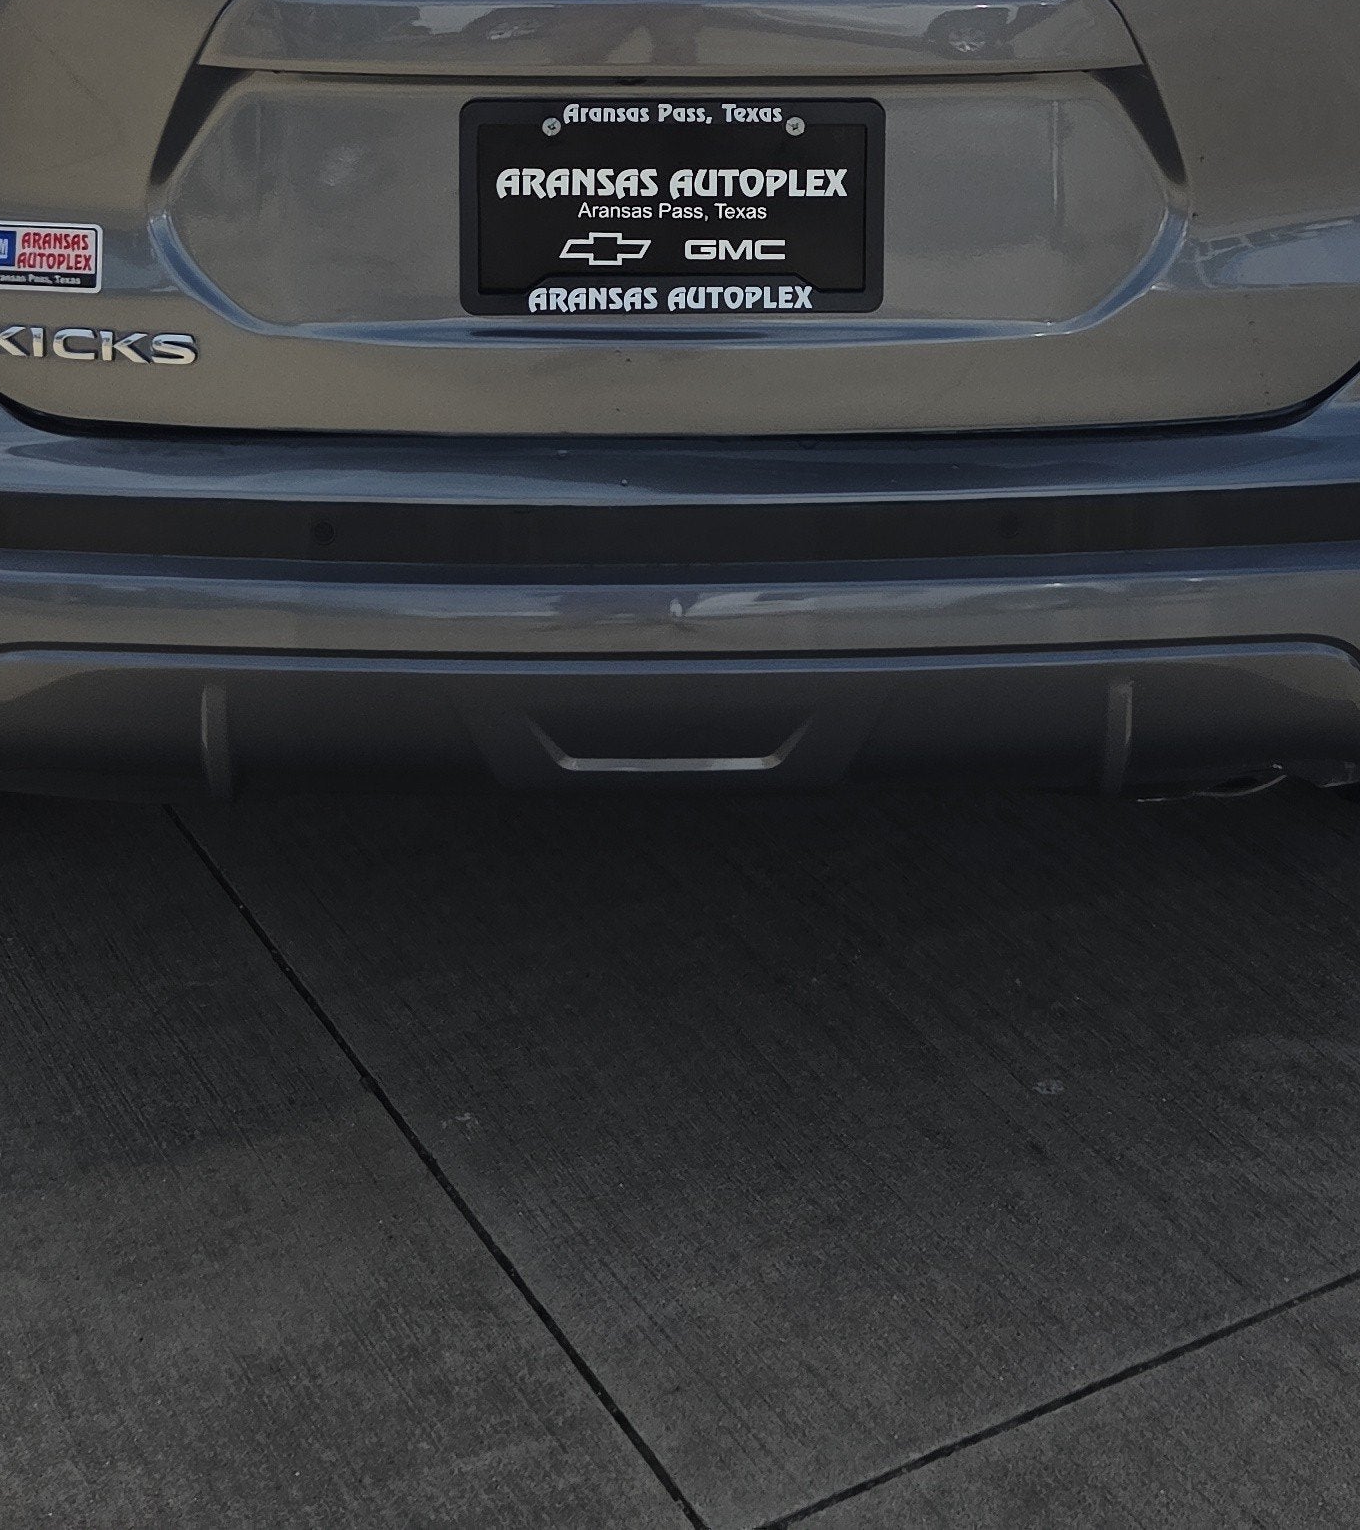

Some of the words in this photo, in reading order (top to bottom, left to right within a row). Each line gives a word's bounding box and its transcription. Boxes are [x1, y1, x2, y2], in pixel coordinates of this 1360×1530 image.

[563, 103, 650, 123] Aransas
[658, 103, 713, 124] Pass,
[722, 103, 783, 123] Texas
[496, 168, 659, 199] ARANSAS
[669, 168, 848, 199] AUTOPLEX
[578, 203, 653, 220] Aransas
[659, 203, 709, 222] Pass,
[715, 203, 767, 220] Texas
[21, 232, 89, 251] ARANSAS
[684, 239, 786, 260] GMC
[17, 251, 93, 271] AUTOPLEX
[55, 274, 81, 285] Texas
[528, 286, 658, 313] ARANSAS
[667, 286, 813, 313] AUTOPLEX
